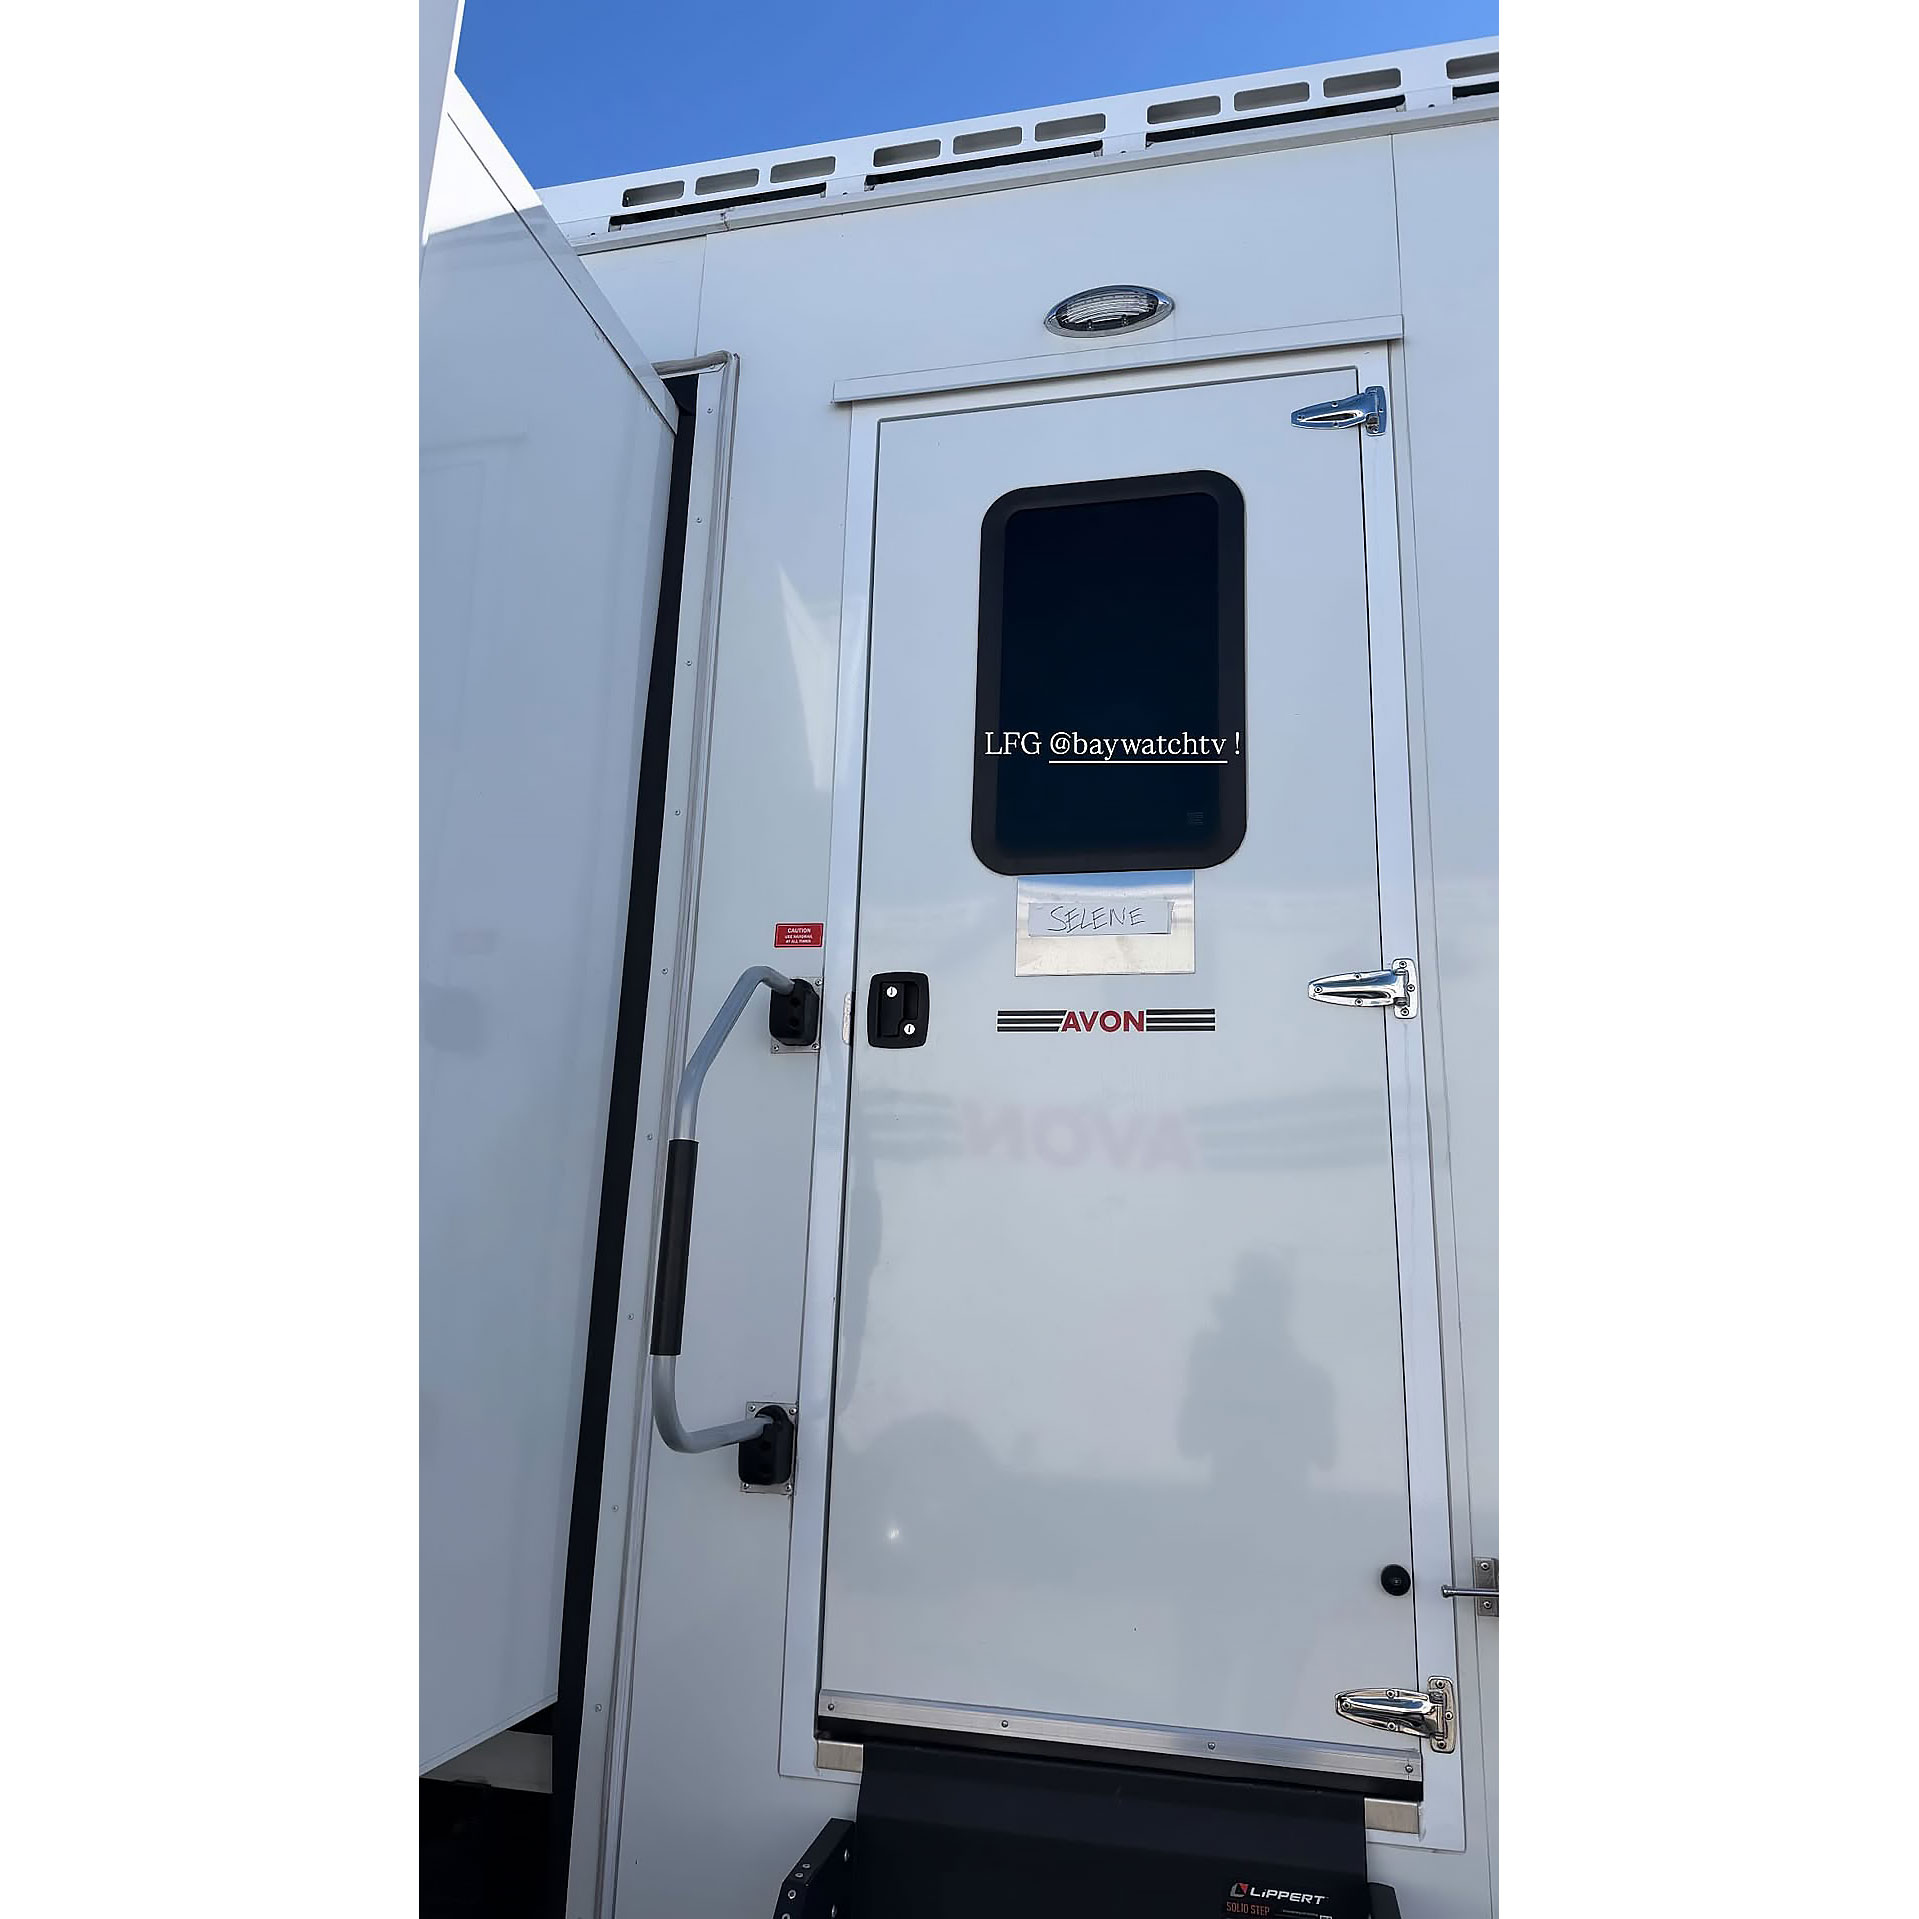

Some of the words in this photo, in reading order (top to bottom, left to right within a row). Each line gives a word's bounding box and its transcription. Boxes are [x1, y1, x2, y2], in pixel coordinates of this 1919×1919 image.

[1047, 905, 1146, 934] SELENE
[1061, 1010, 1145, 1032] AVON
[1226, 1901, 1249, 1914] SOLID
[1250, 1904, 1270, 1917] STEP
